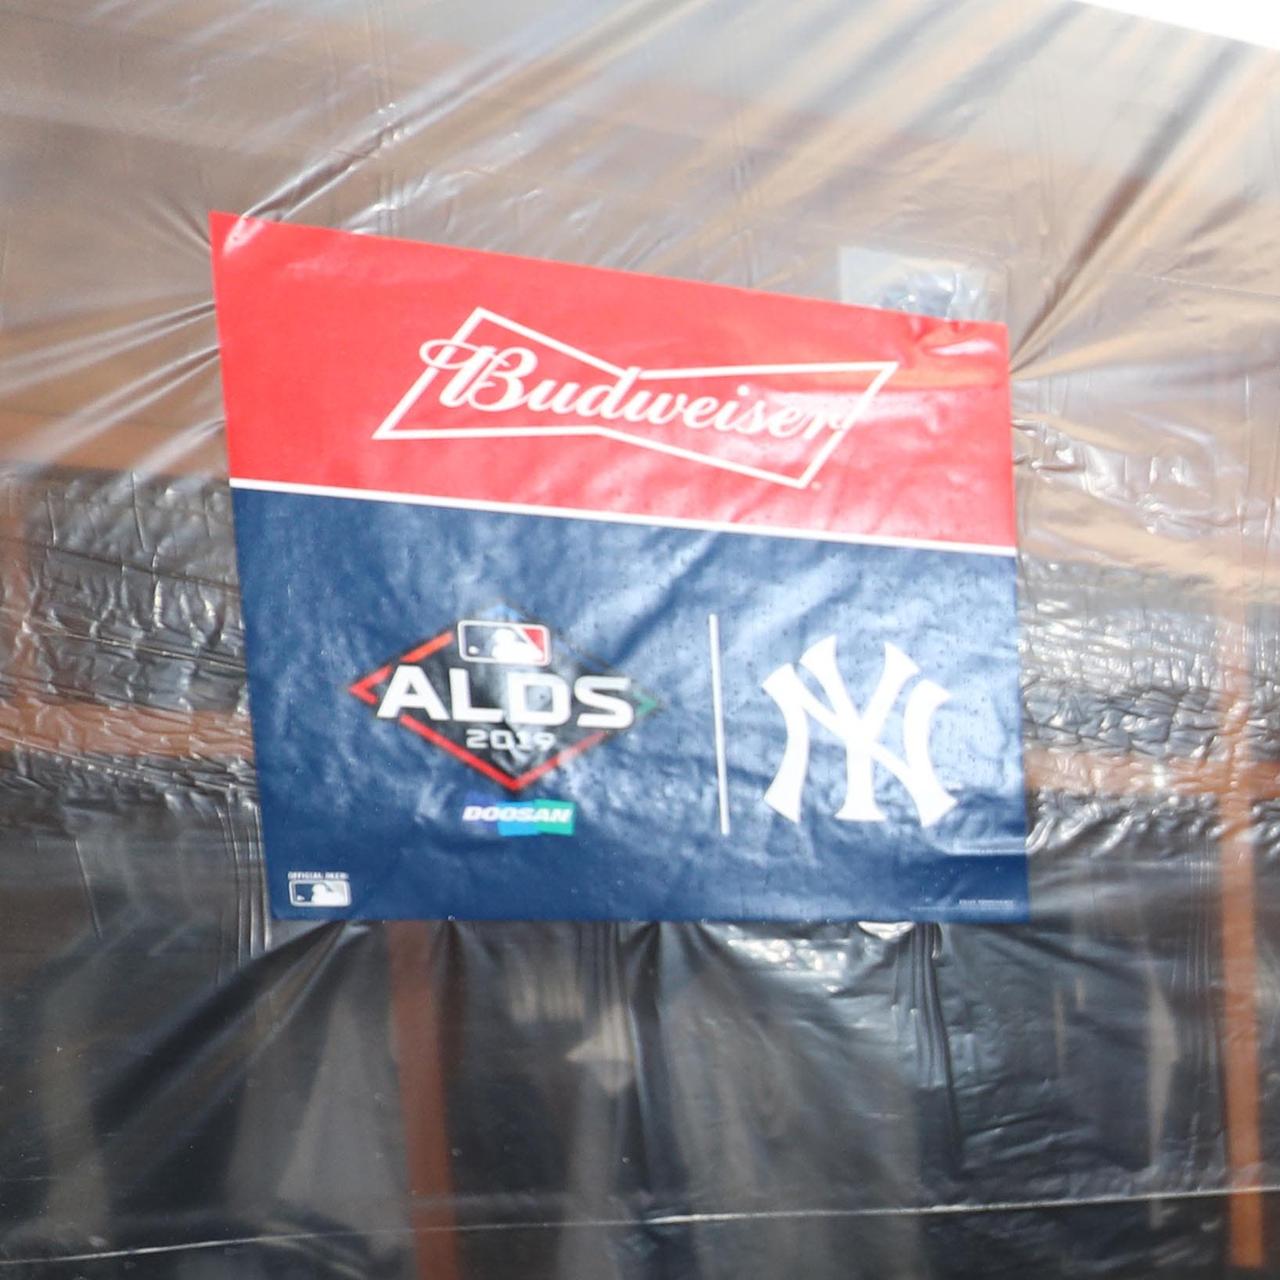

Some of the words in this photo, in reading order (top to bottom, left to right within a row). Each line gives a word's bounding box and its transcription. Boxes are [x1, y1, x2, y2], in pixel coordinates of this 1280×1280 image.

[419, 338, 846, 440] Budweiser
[377, 664, 635, 729] ALDS
[465, 728, 557, 751] 2019
[462, 805, 575, 823] DOOSAN
